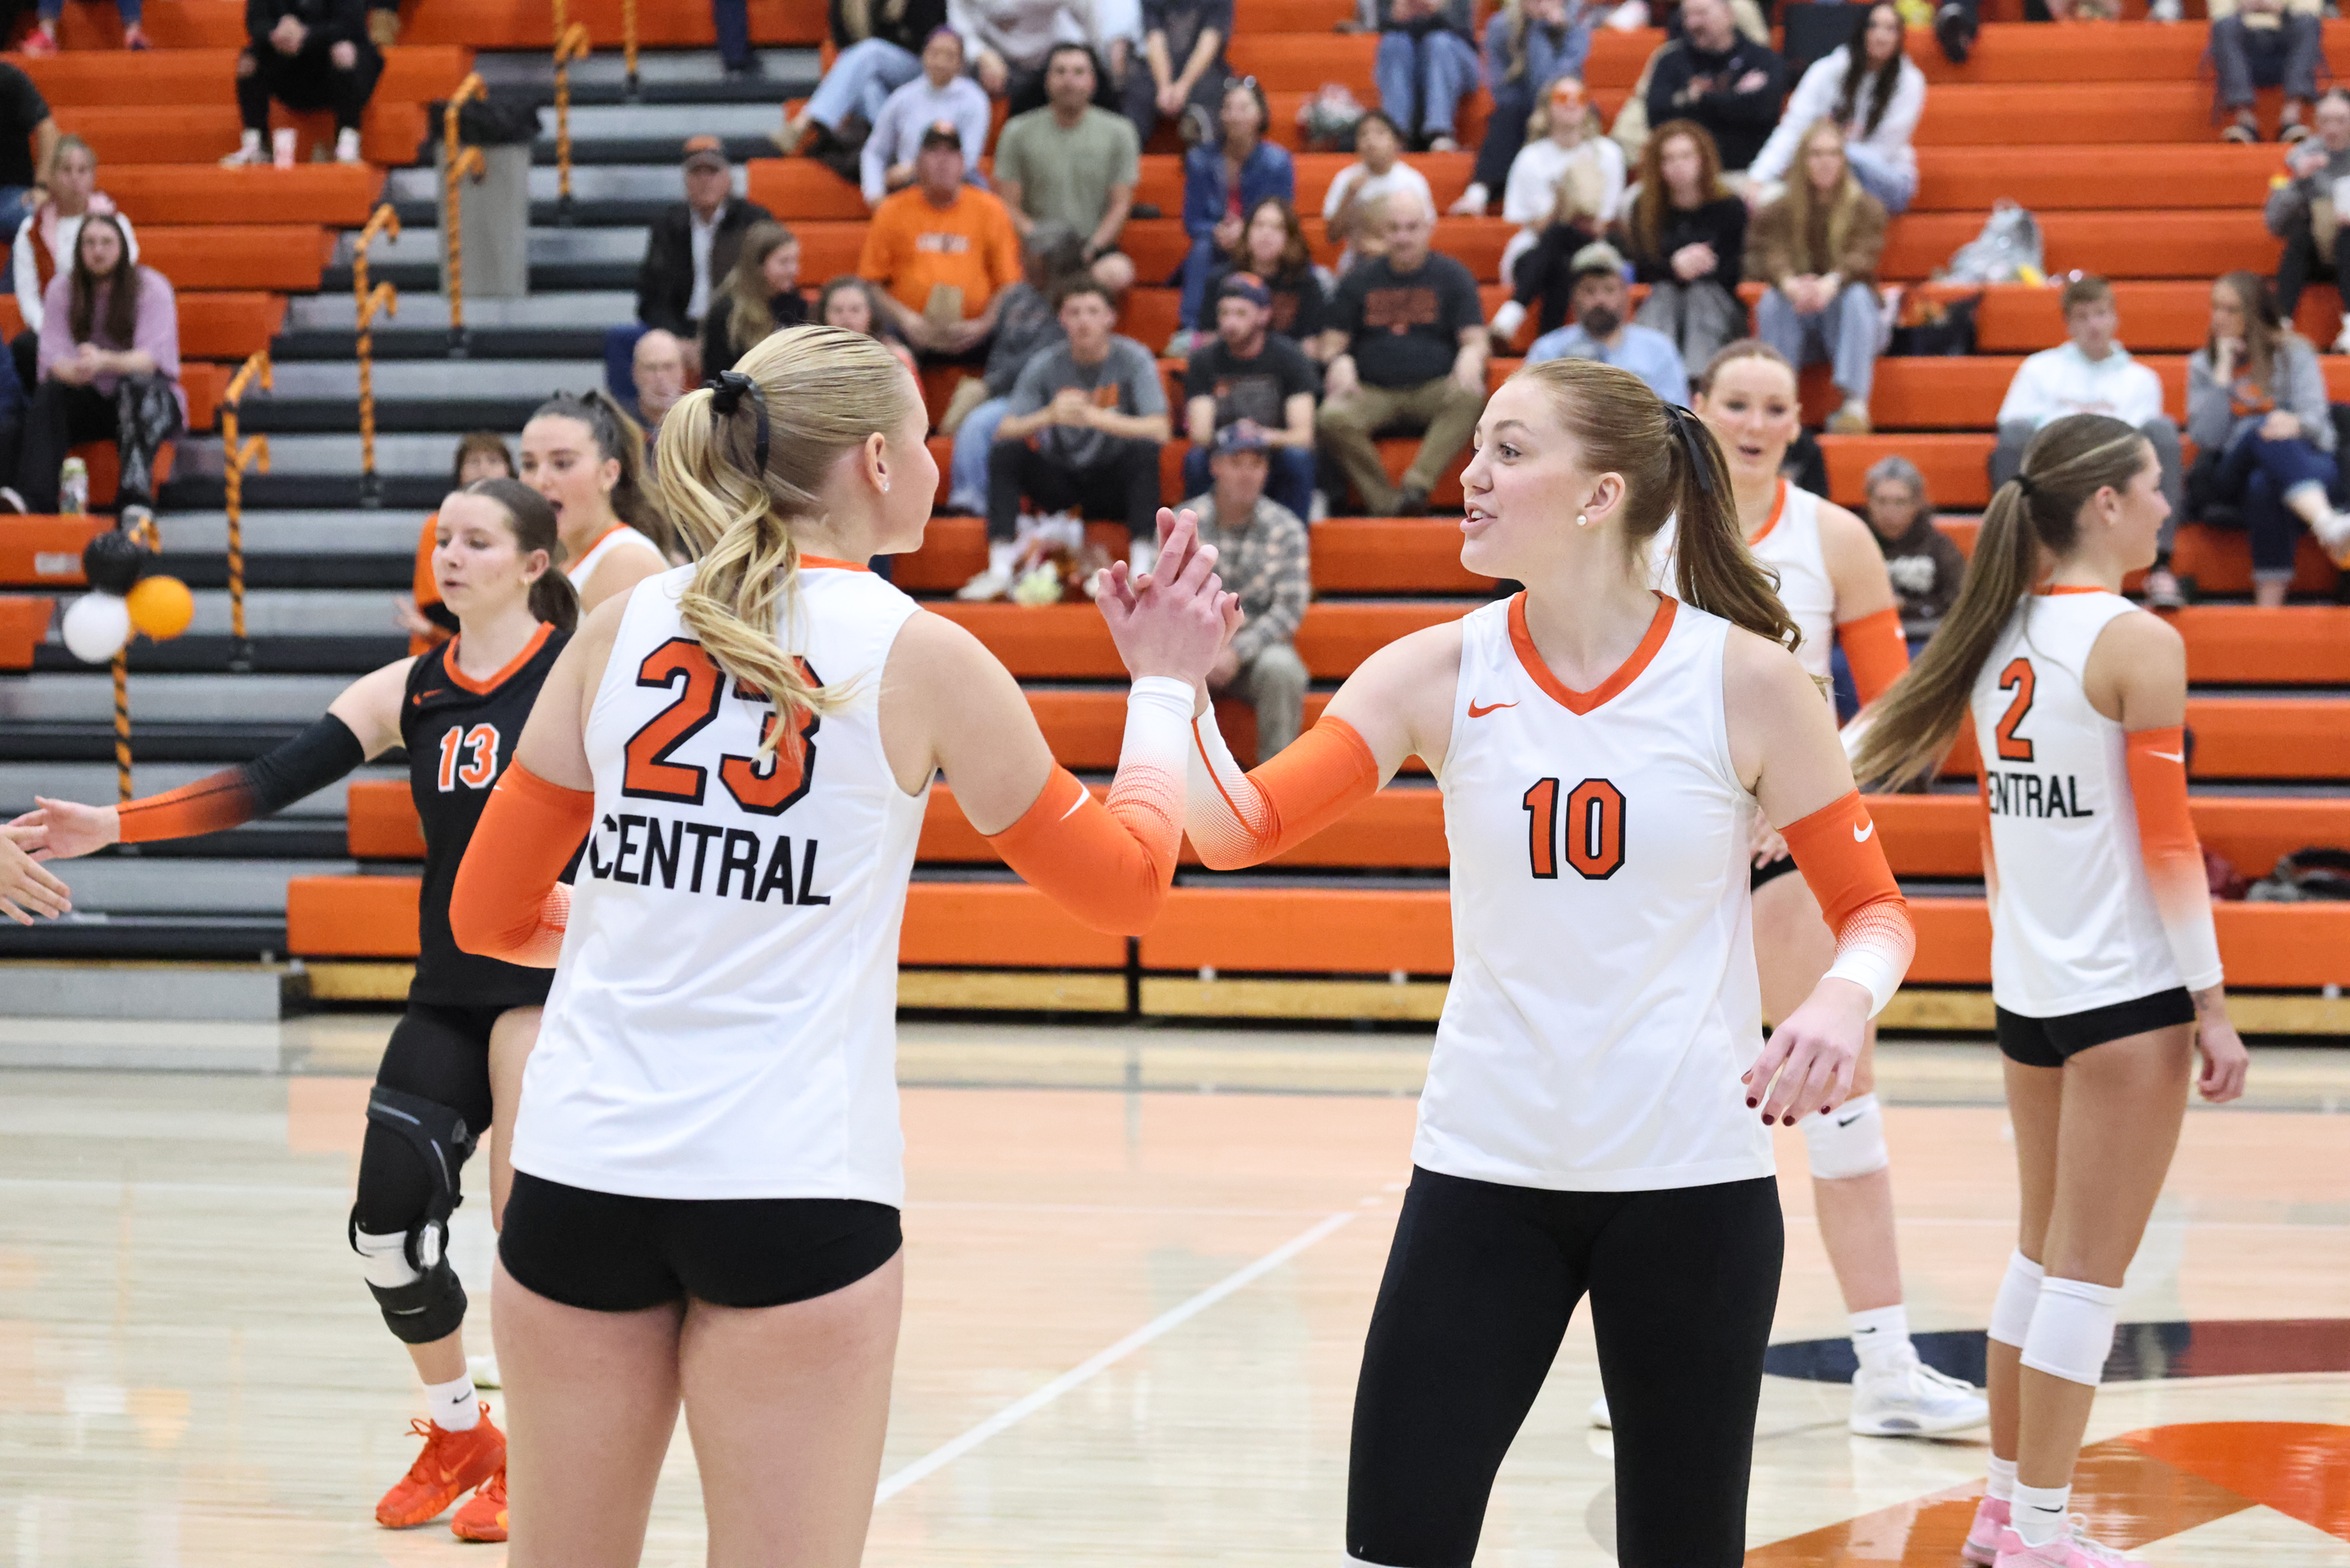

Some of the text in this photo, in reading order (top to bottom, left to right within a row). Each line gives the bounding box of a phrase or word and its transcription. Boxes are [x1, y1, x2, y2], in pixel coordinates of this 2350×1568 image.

[438, 722, 500, 793] 13
[622, 637, 824, 816] 23
[1996, 657, 2036, 762] 2
[1522, 777, 1626, 880] 10
[1987, 772, 2094, 819] ENTRAL
[589, 814, 831, 906] CENTRAL
